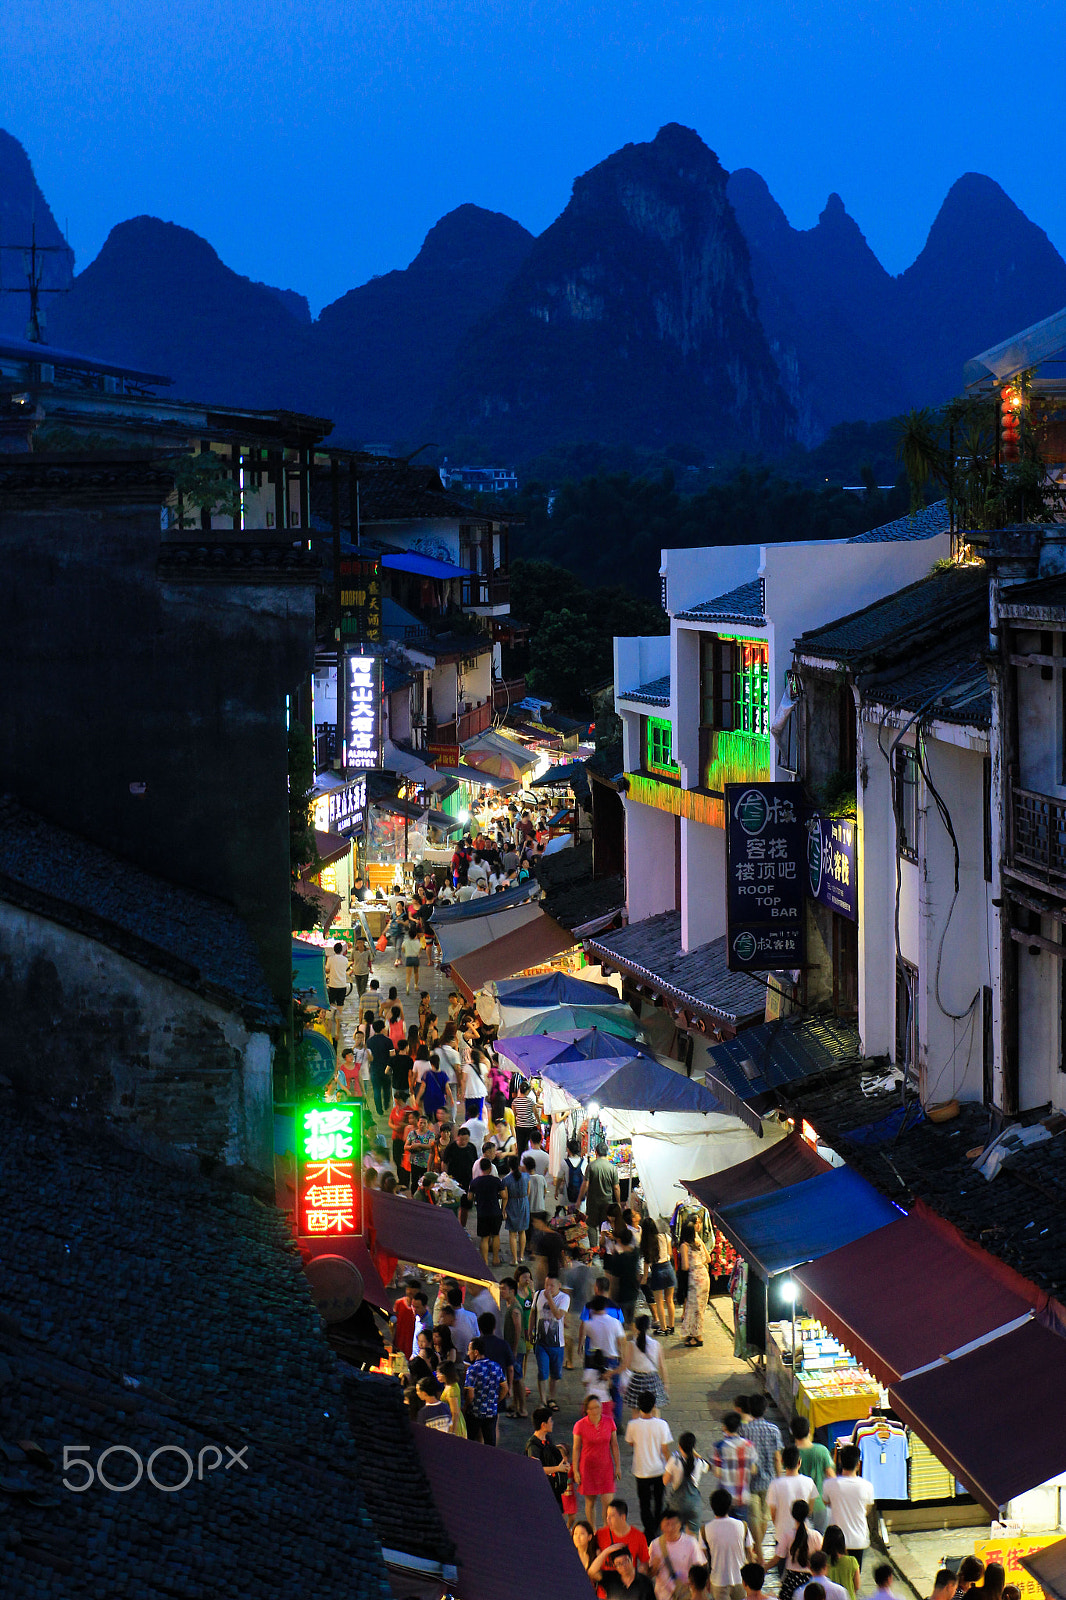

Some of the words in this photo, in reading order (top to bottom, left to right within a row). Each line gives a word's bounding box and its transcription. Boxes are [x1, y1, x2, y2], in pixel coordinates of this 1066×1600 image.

[340, 590, 367, 606] ROOFTOP
[350, 657, 375, 749] 阿里山大酒店
[348, 758, 376, 768] HOTEL
[329, 783, 367, 822] 阿里山大酒店
[746, 838, 788, 860] 客栈
[735, 861, 797, 881] 楼顶吧
[738, 885, 775, 895] ROOF
[755, 896, 782, 906] TOP
[771, 907, 798, 917] BAR
[303, 1108, 354, 1232] 核桃木锤酥
